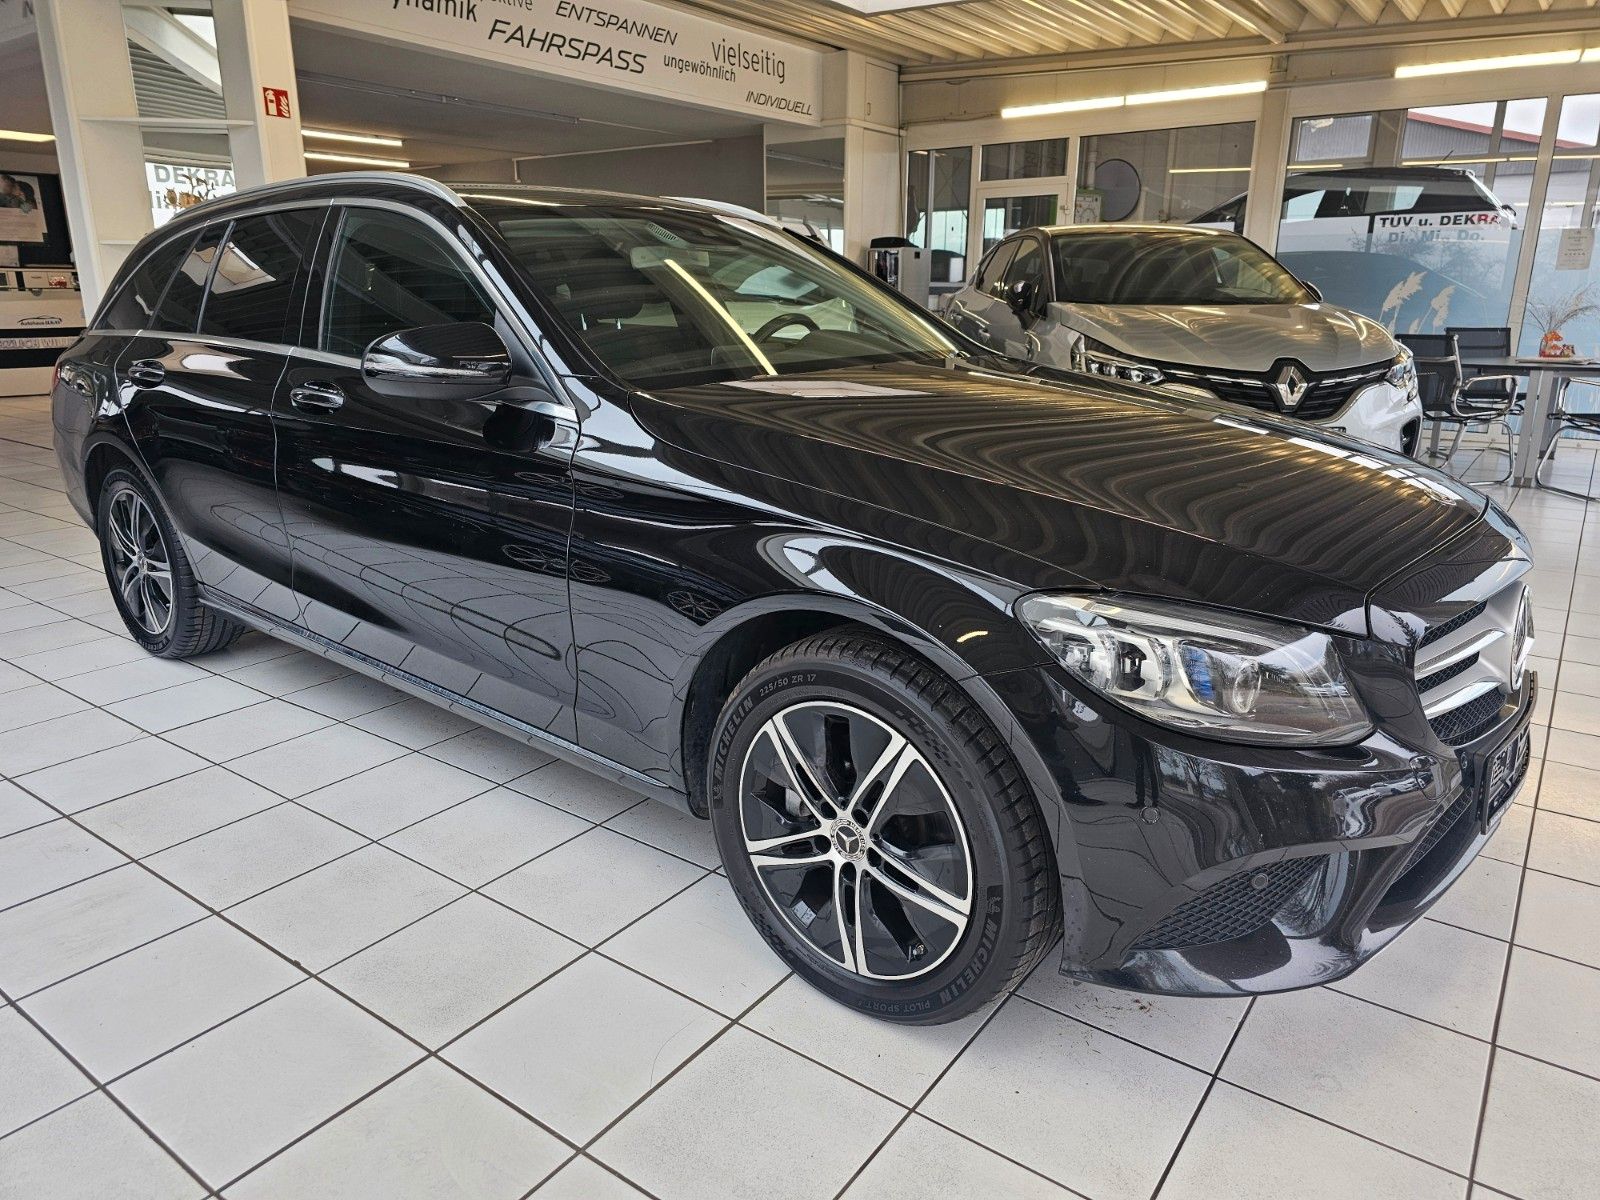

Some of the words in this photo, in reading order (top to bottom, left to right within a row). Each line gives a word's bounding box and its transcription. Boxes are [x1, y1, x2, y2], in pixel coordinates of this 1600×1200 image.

[555, 1, 678, 46] ENTSPANNEN
[487, 19, 648, 75] FAHRSPASS
[663, 54, 736, 83] ungewöhnlich
[711, 38, 786, 84] vielseitig
[746, 90, 813, 116] INDIVIDUELL
[154, 165, 235, 187] DEKRA
[1379, 213, 1414, 228] TÜV
[1419, 217, 1433, 227] u.
[1439, 213, 1502, 227] DEKRA
[759, 676, 789, 697] 225/50
[791, 674, 804, 684] ZR
[807, 673, 817, 683] 17
[713, 695, 754, 782] MICHELIN
[939, 918, 999, 1005] MICHELIN
[865, 1001, 900, 1013] SPORT
[903, 999, 931, 1013] PILOT
